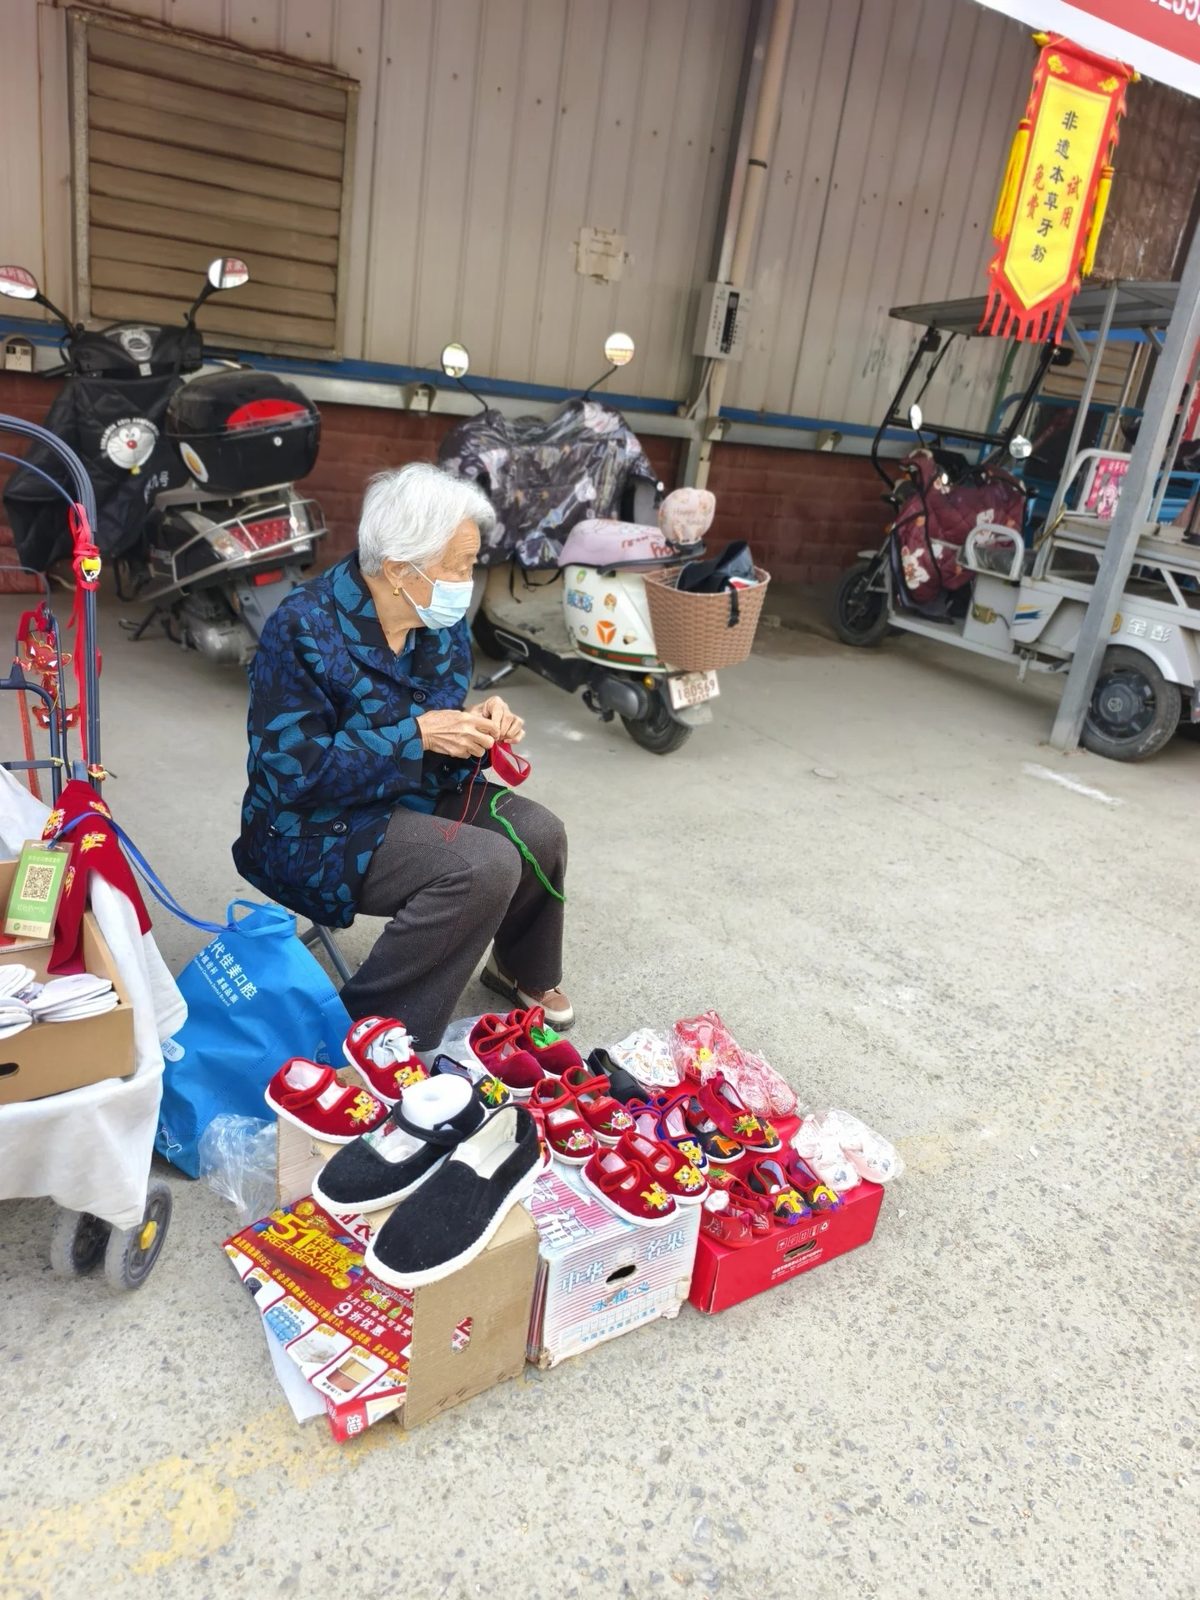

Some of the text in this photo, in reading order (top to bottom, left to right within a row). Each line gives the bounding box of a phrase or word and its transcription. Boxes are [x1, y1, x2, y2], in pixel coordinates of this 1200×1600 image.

[1031, 110, 1078, 263] 非遗本草牙粉
[1126, 618, 1172, 643] 金彭
[267, 1213, 316, 1249] 51
[257, 1230, 342, 1281] PREFERENTIAL
[561, 1262, 604, 1294] 中华
[333, 1300, 388, 1338] 9折优惠
